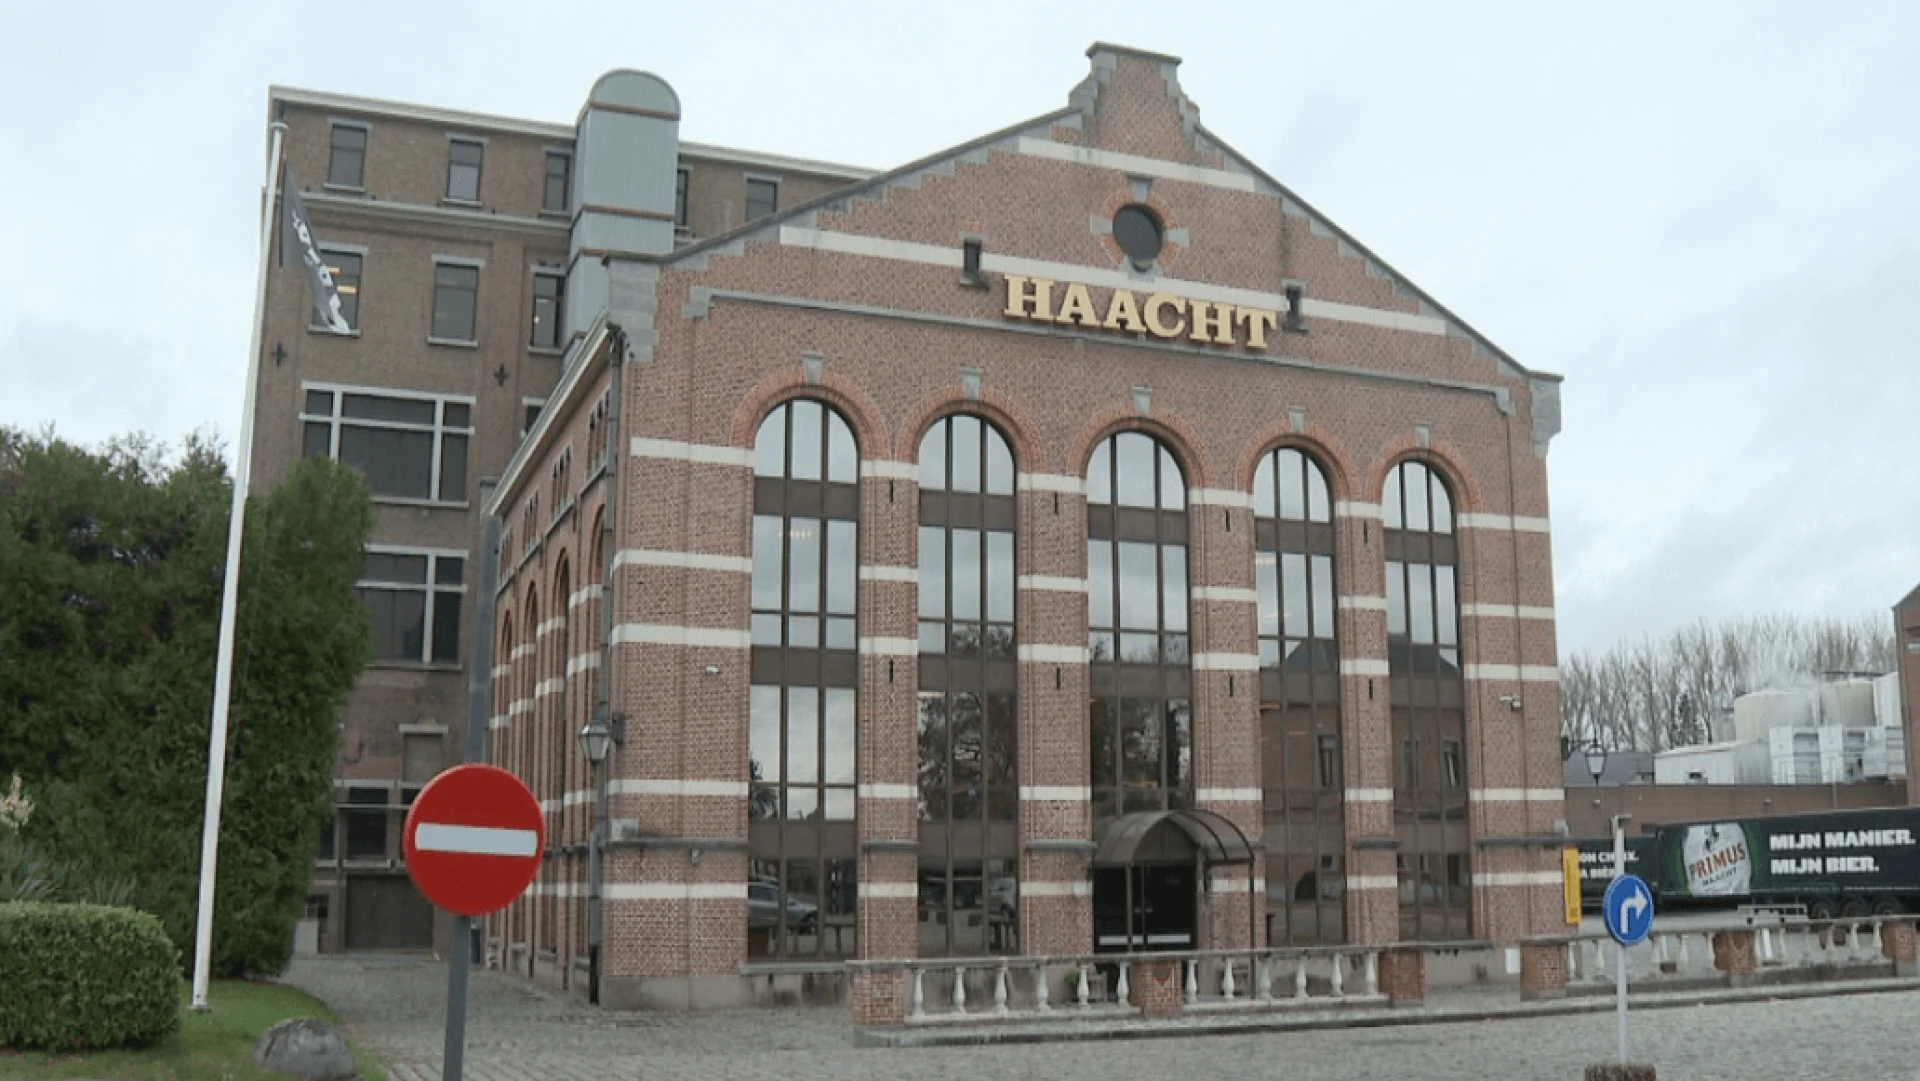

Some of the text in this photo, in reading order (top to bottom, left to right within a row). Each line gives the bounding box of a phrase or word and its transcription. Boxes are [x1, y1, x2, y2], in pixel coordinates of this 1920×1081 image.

[1004, 274, 1277, 348] HAACHT
[1770, 829, 1916, 851] MIJN MANIER.
[1688, 842, 1746, 881] PRIMUS
[1771, 857, 1880, 875] MIJN BIER.
